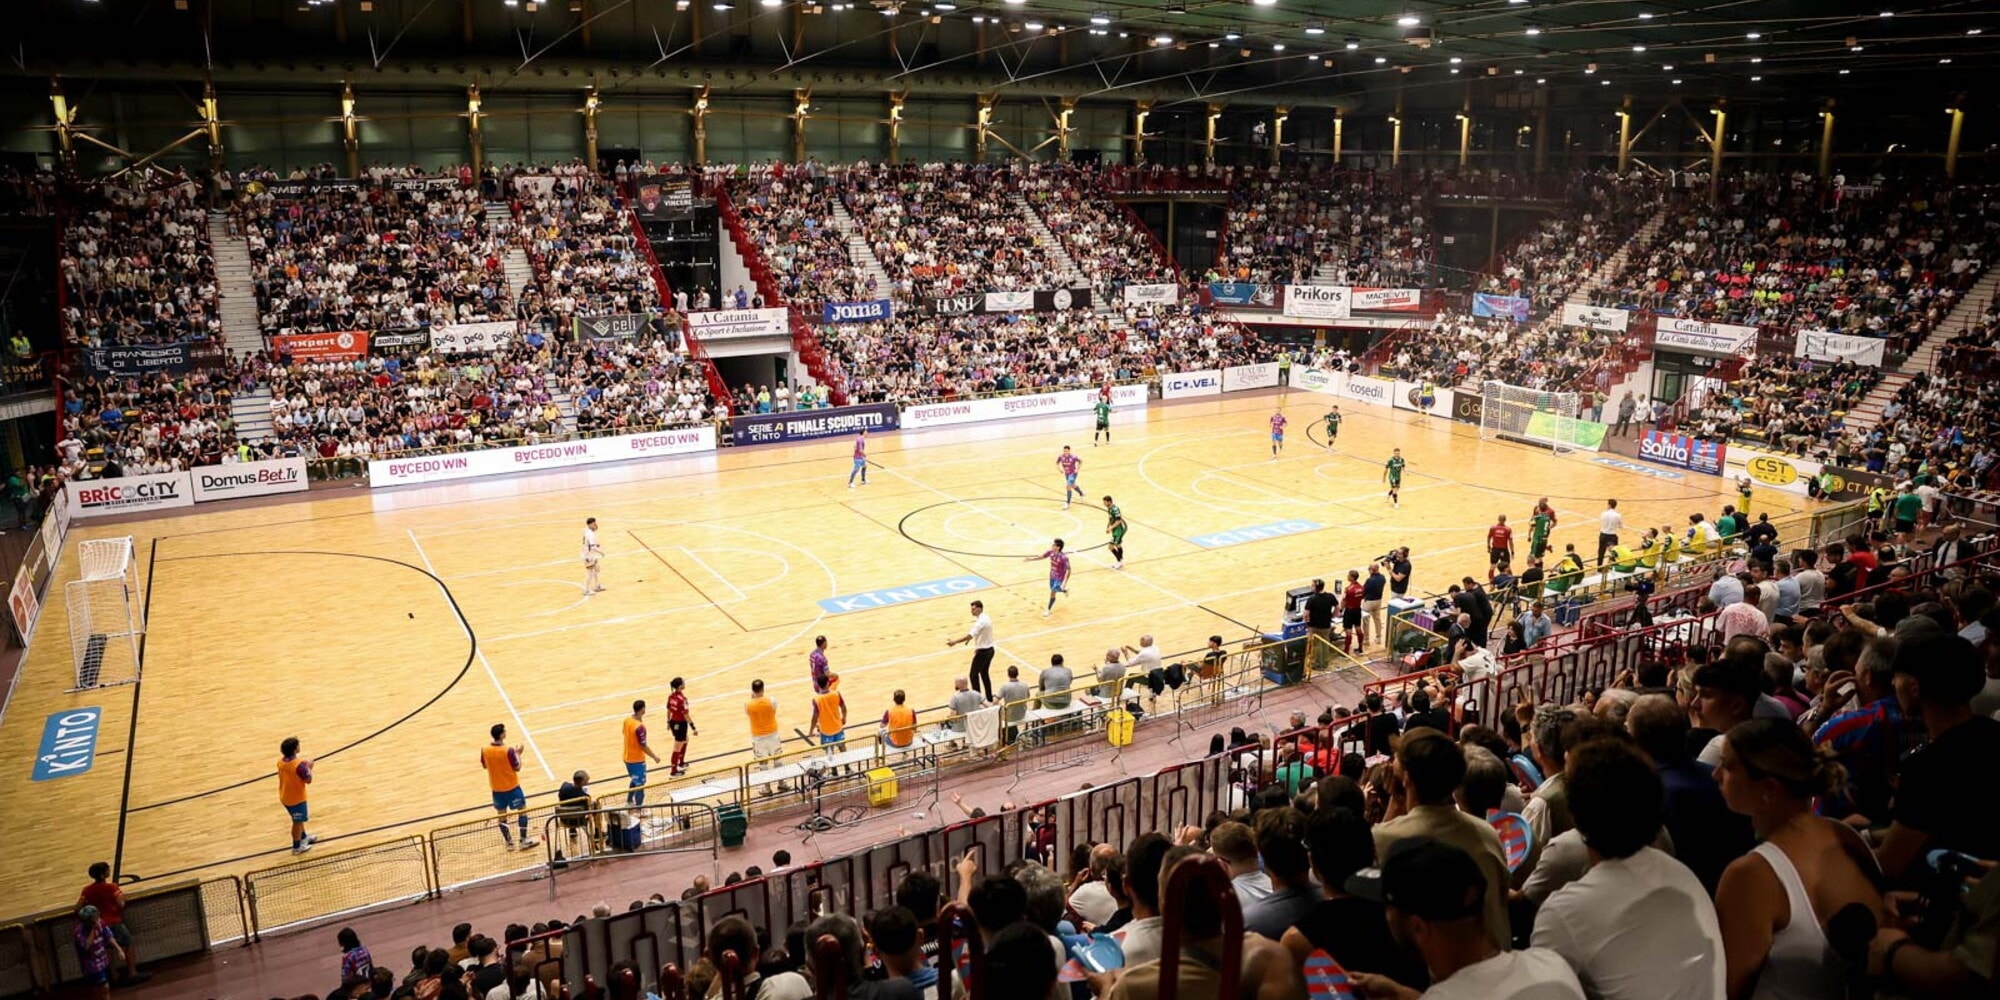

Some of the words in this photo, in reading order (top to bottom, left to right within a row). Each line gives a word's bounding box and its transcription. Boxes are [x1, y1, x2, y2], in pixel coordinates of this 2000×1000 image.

[1294, 286, 1342, 301] PriKors
[713, 311, 759, 323] Catania
[705, 327, 725, 338] Sport
[1674, 320, 1718, 335] Catania
[1690, 335, 1708, 347] dello
[1709, 338, 1732, 350] Sport
[112, 347, 182, 359] FRANCESCO
[113, 360, 125, 368] DI
[136, 356, 184, 367] LIBERTO
[1350, 383, 1384, 399] cosedil
[1040, 397, 1056, 406] WIN
[952, 405, 971, 415] WIN
[748, 422, 773, 434] SERIE
[774, 422, 784, 432] A
[787, 418, 826, 434] FINALE
[827, 412, 883, 430] SCUDETTO
[677, 432, 699, 443] WIN
[752, 431, 781, 441] KINTO
[564, 444, 587, 456] WIN
[442, 457, 467, 469] WIN
[1755, 458, 1790, 474] CST
[1847, 481, 1861, 493] CT
[1204, 520, 1312, 547] KINTO
[834, 577, 979, 611] KINTO
[41, 712, 97, 774] KINTO
